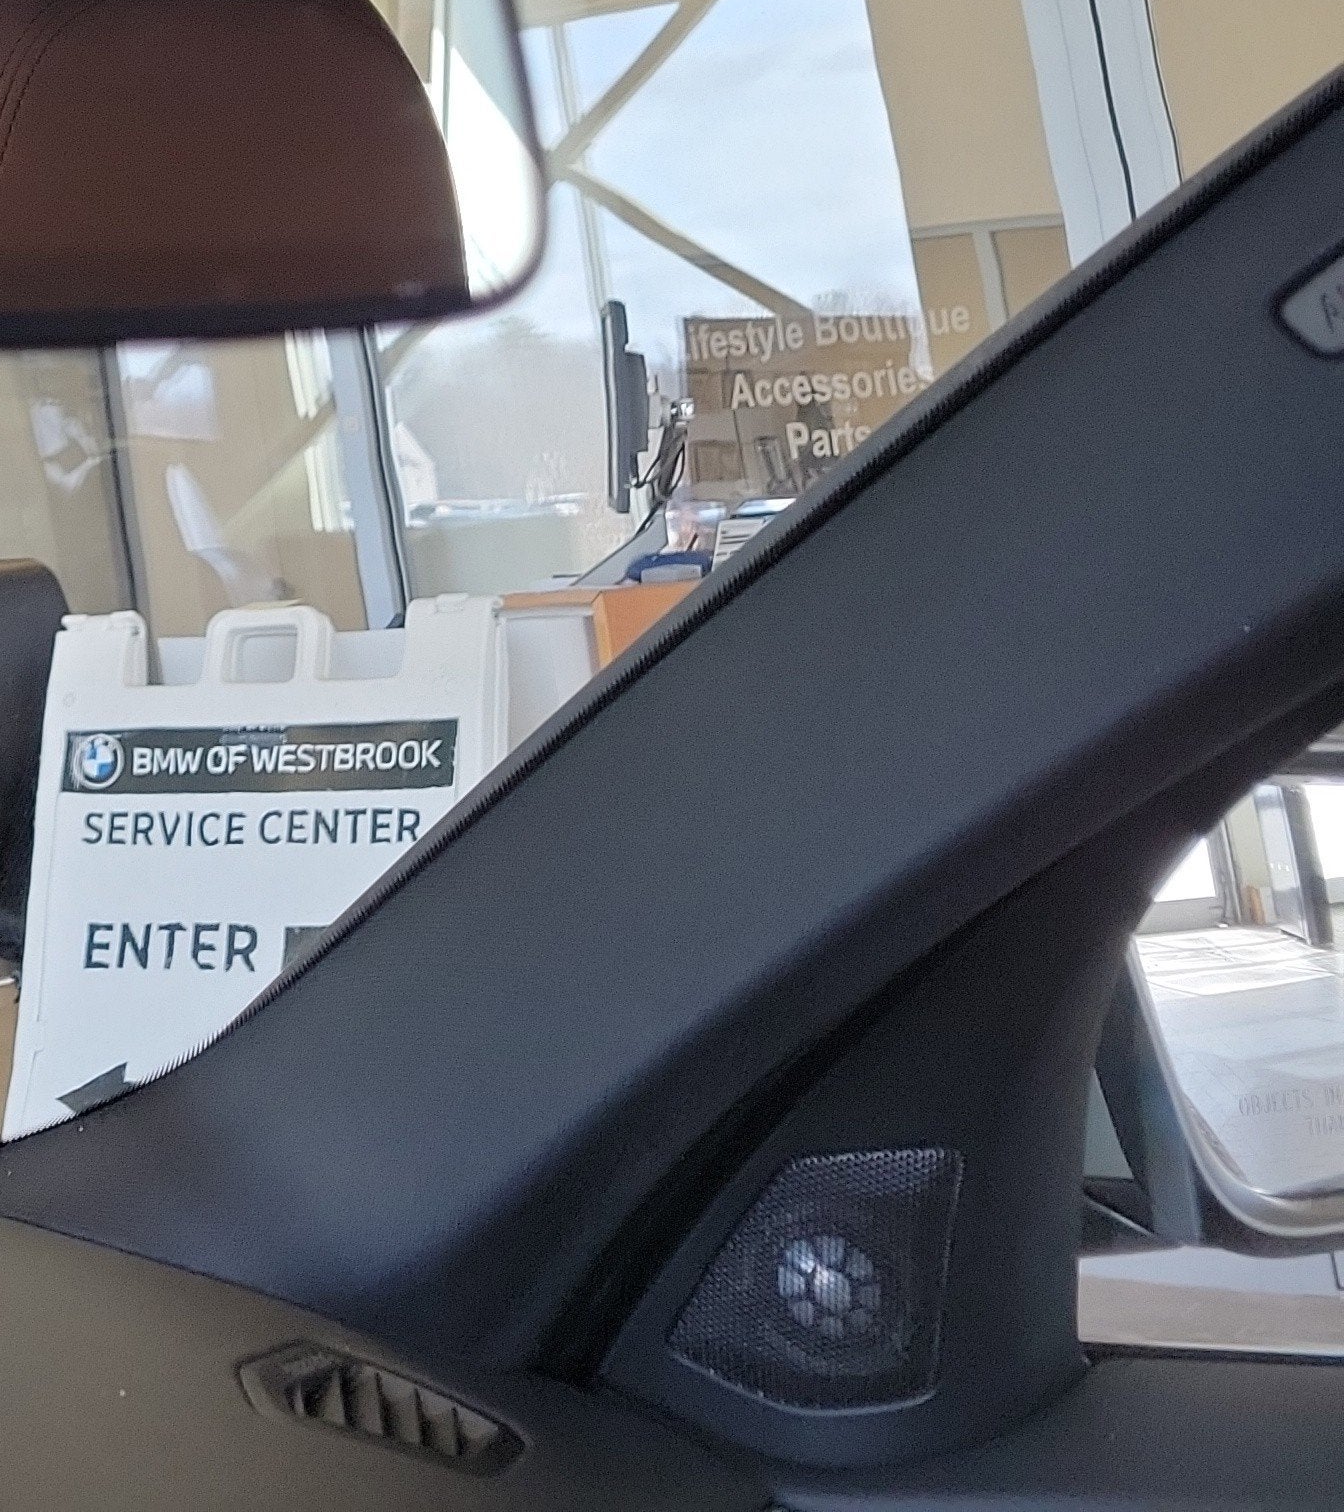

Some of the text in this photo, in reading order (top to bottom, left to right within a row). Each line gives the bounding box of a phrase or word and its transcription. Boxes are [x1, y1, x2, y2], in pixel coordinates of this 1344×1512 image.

[686, 305, 971, 363] ifestyle Boutiue
[132, 739, 443, 776] BMW OF WESTBROOK
[81, 807, 422, 847] SERVICE CENTER
[83, 922, 259, 972] ENTER
[1238, 1088, 1314, 1116] OBJECTS
